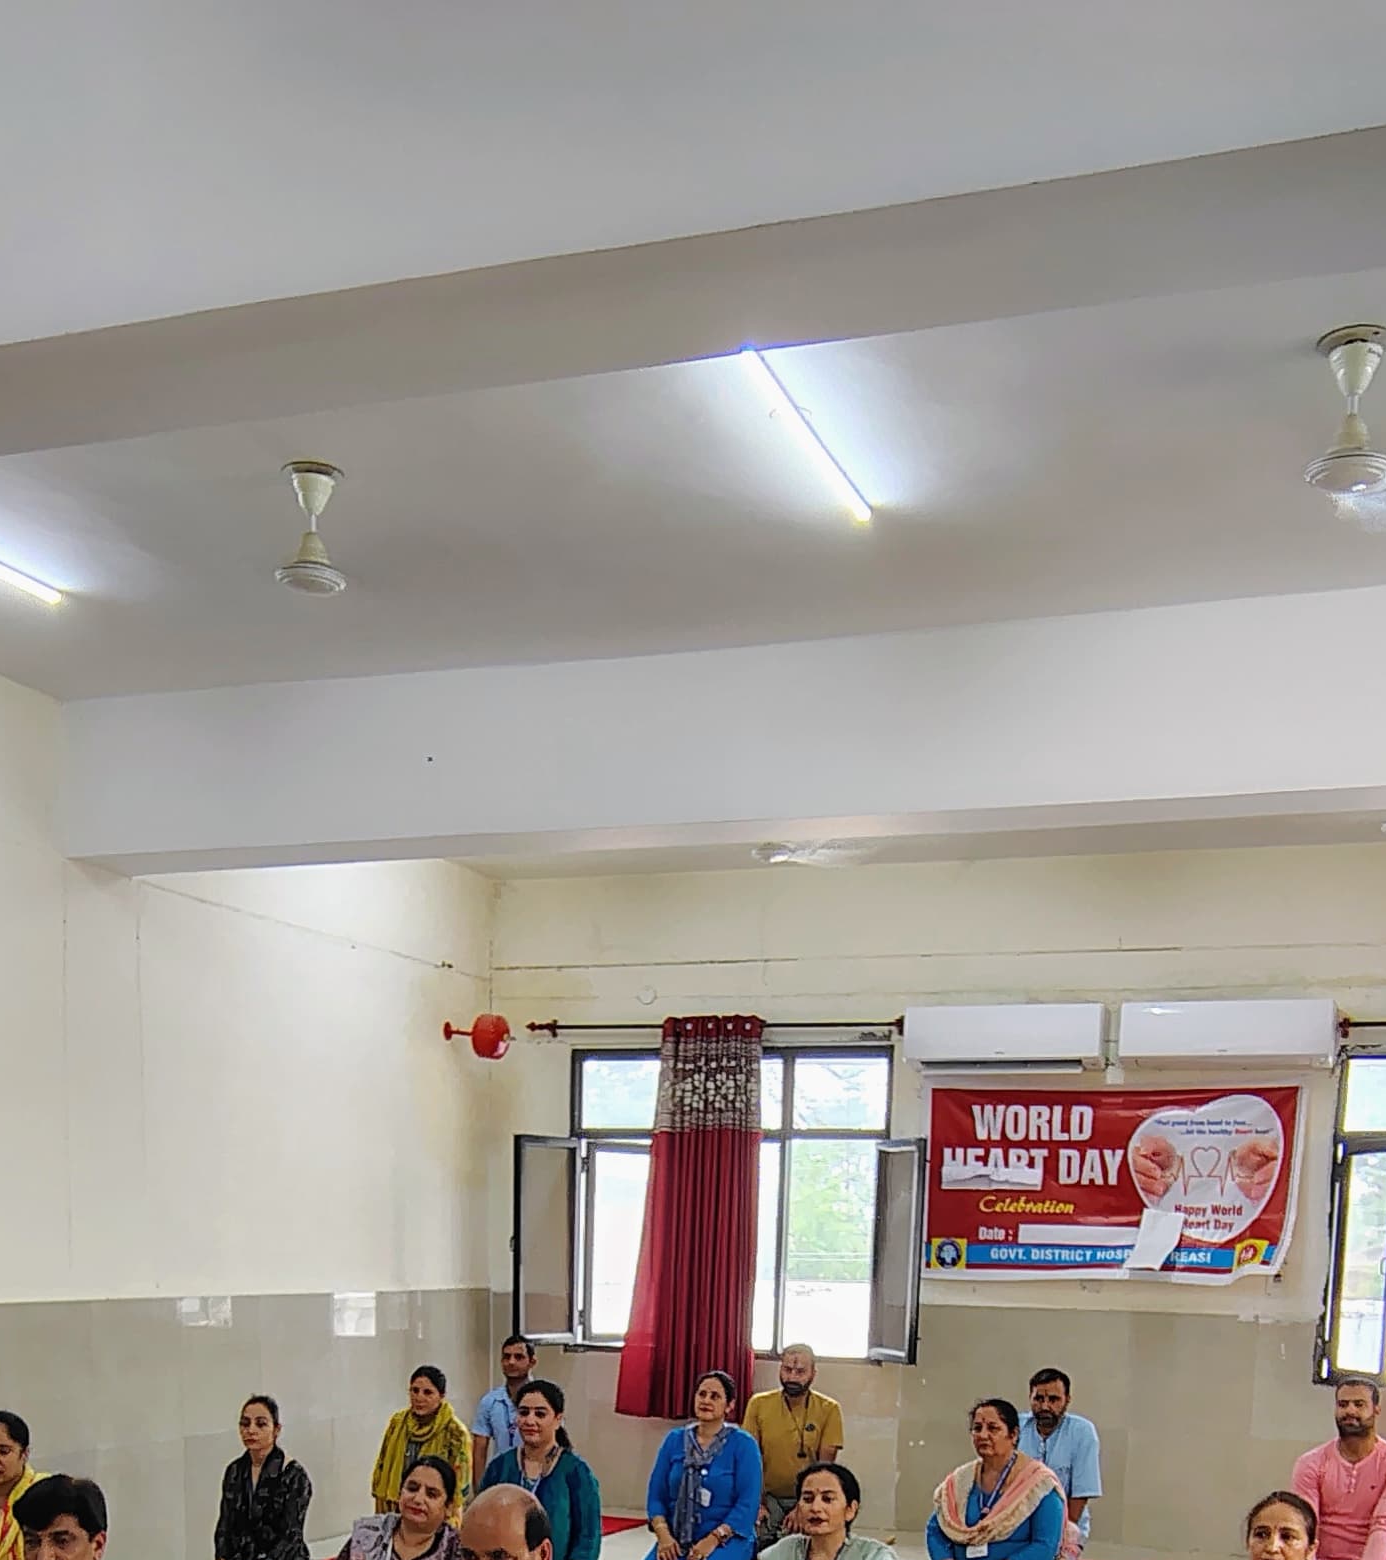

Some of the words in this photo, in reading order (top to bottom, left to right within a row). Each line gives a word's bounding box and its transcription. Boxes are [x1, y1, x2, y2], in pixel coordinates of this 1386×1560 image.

[972, 1104, 1094, 1141] WORLD
[1058, 1149, 1125, 1185] DAY
[979, 1196, 1075, 1214] Celebration
[1174, 1204, 1207, 1217] Happy
[1211, 1204, 1243, 1216] World
[1214, 1218, 1235, 1232] Day
[978, 1227, 1005, 1240] Date
[990, 1247, 1027, 1260] GOVT.
[1031, 1248, 1092, 1262] DISTRICT
[1170, 1251, 1212, 1263] REASI
